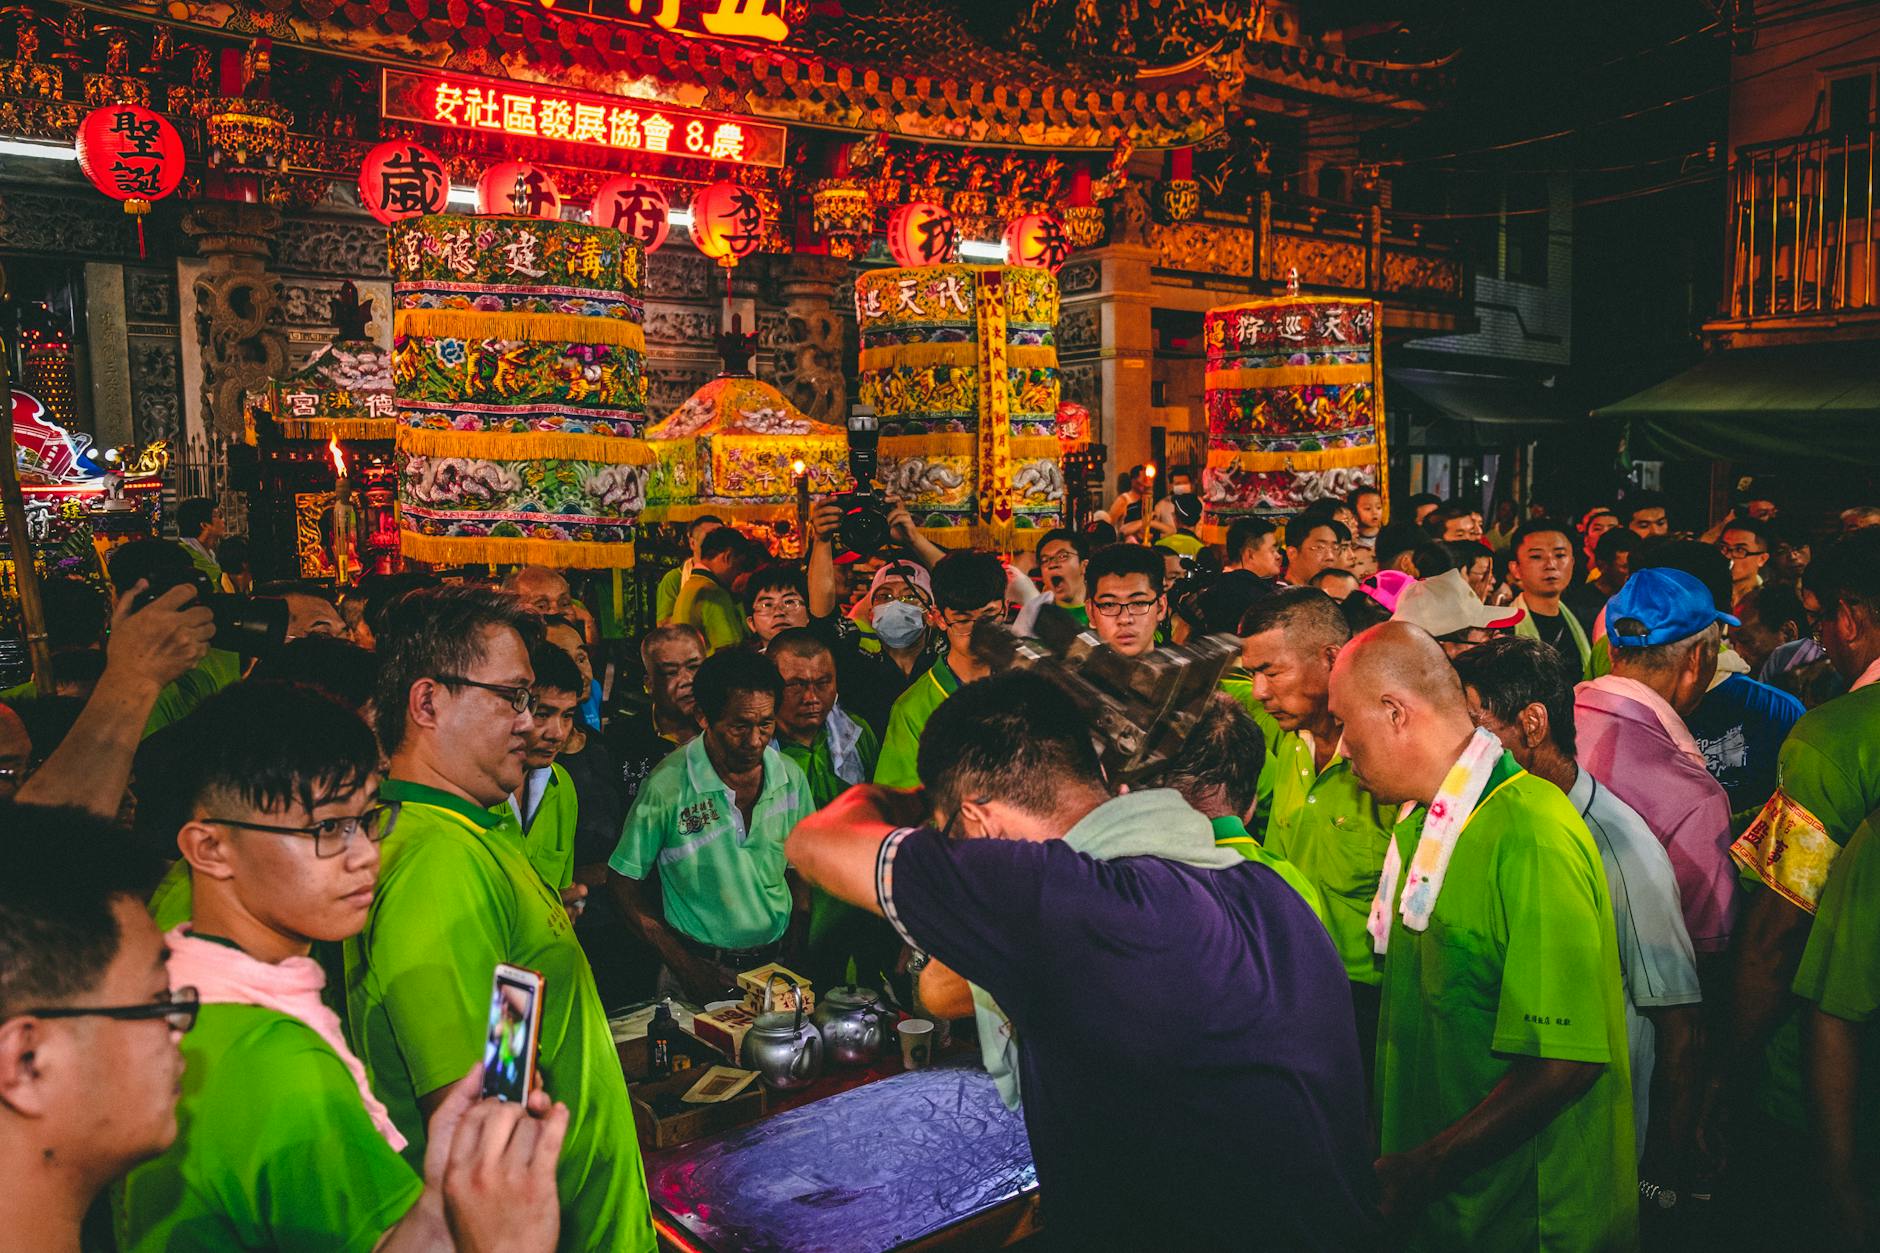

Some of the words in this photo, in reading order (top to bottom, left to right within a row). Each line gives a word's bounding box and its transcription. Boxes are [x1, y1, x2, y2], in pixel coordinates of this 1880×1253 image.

[109, 112, 168, 196] 聖誕
[381, 146, 445, 216] 歲
[611, 183, 664, 247] 府
[718, 187, 762, 253] 李
